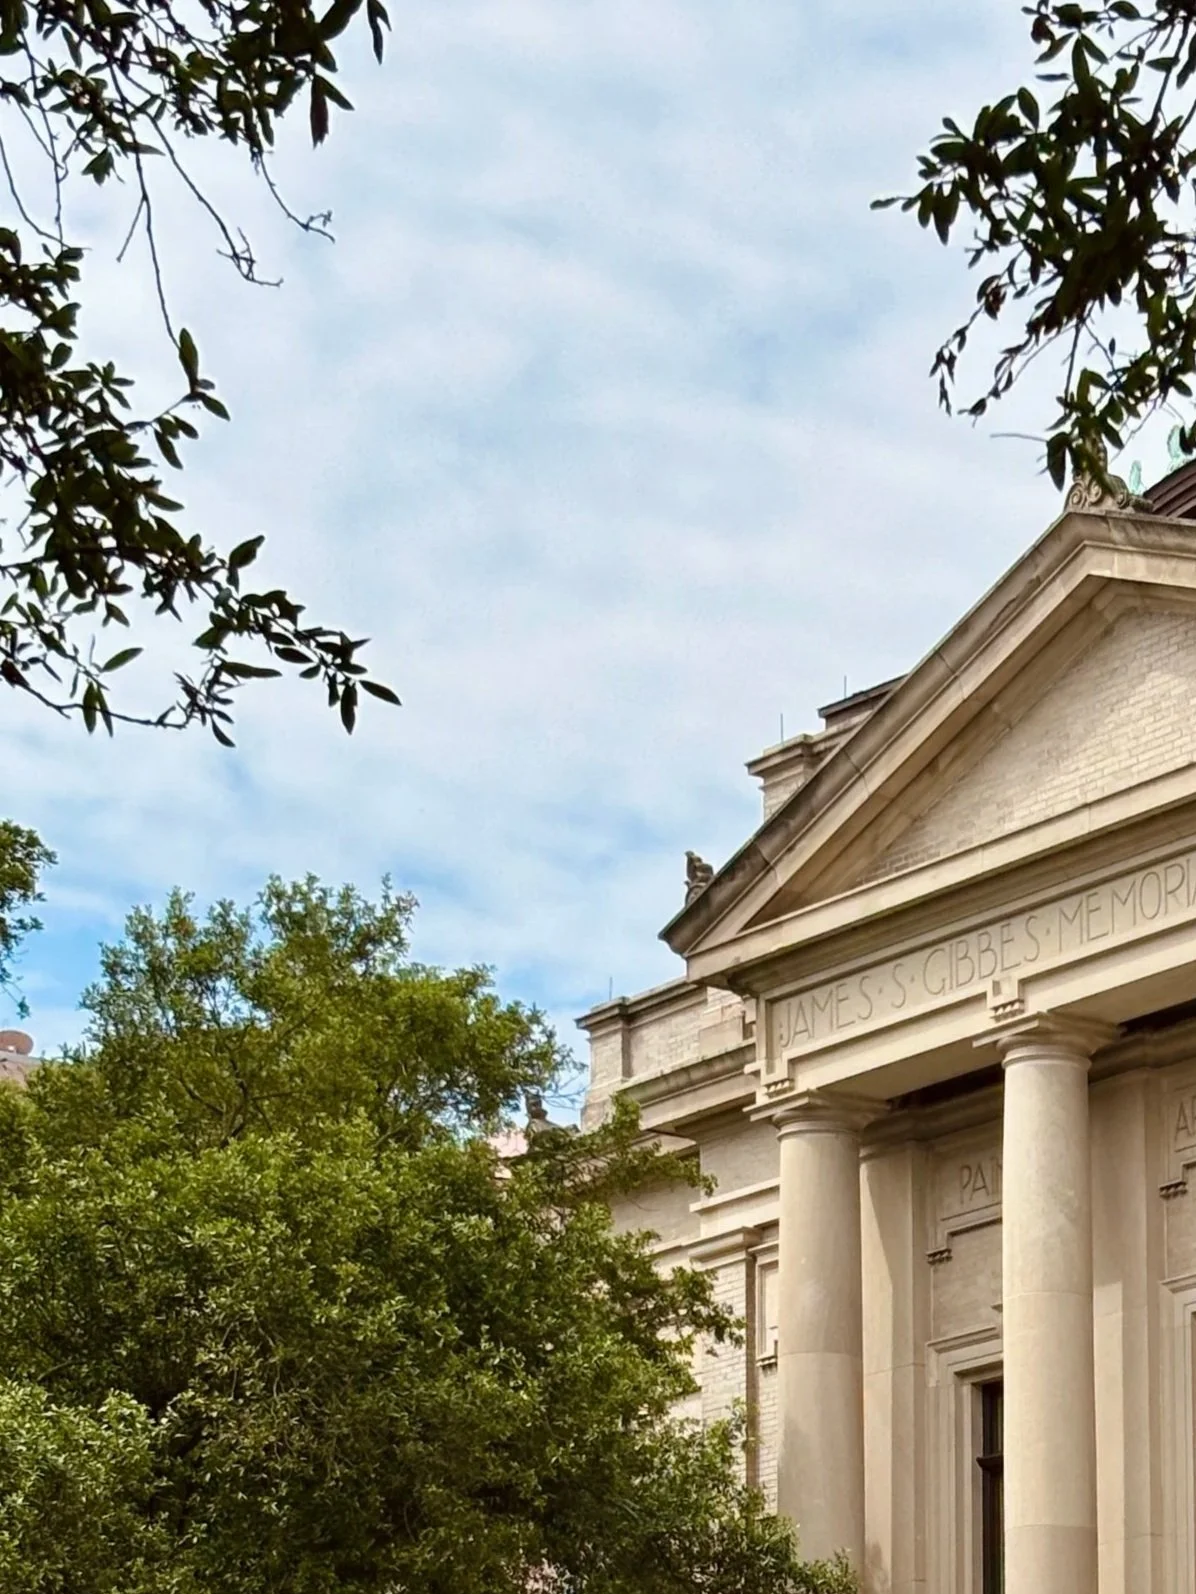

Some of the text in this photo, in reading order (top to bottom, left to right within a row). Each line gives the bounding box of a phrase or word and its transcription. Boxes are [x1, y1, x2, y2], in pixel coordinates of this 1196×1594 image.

[780, 975, 873, 1048] JAMES
[892, 962, 906, 1010] S
[922, 916, 1040, 997] GIBBES
